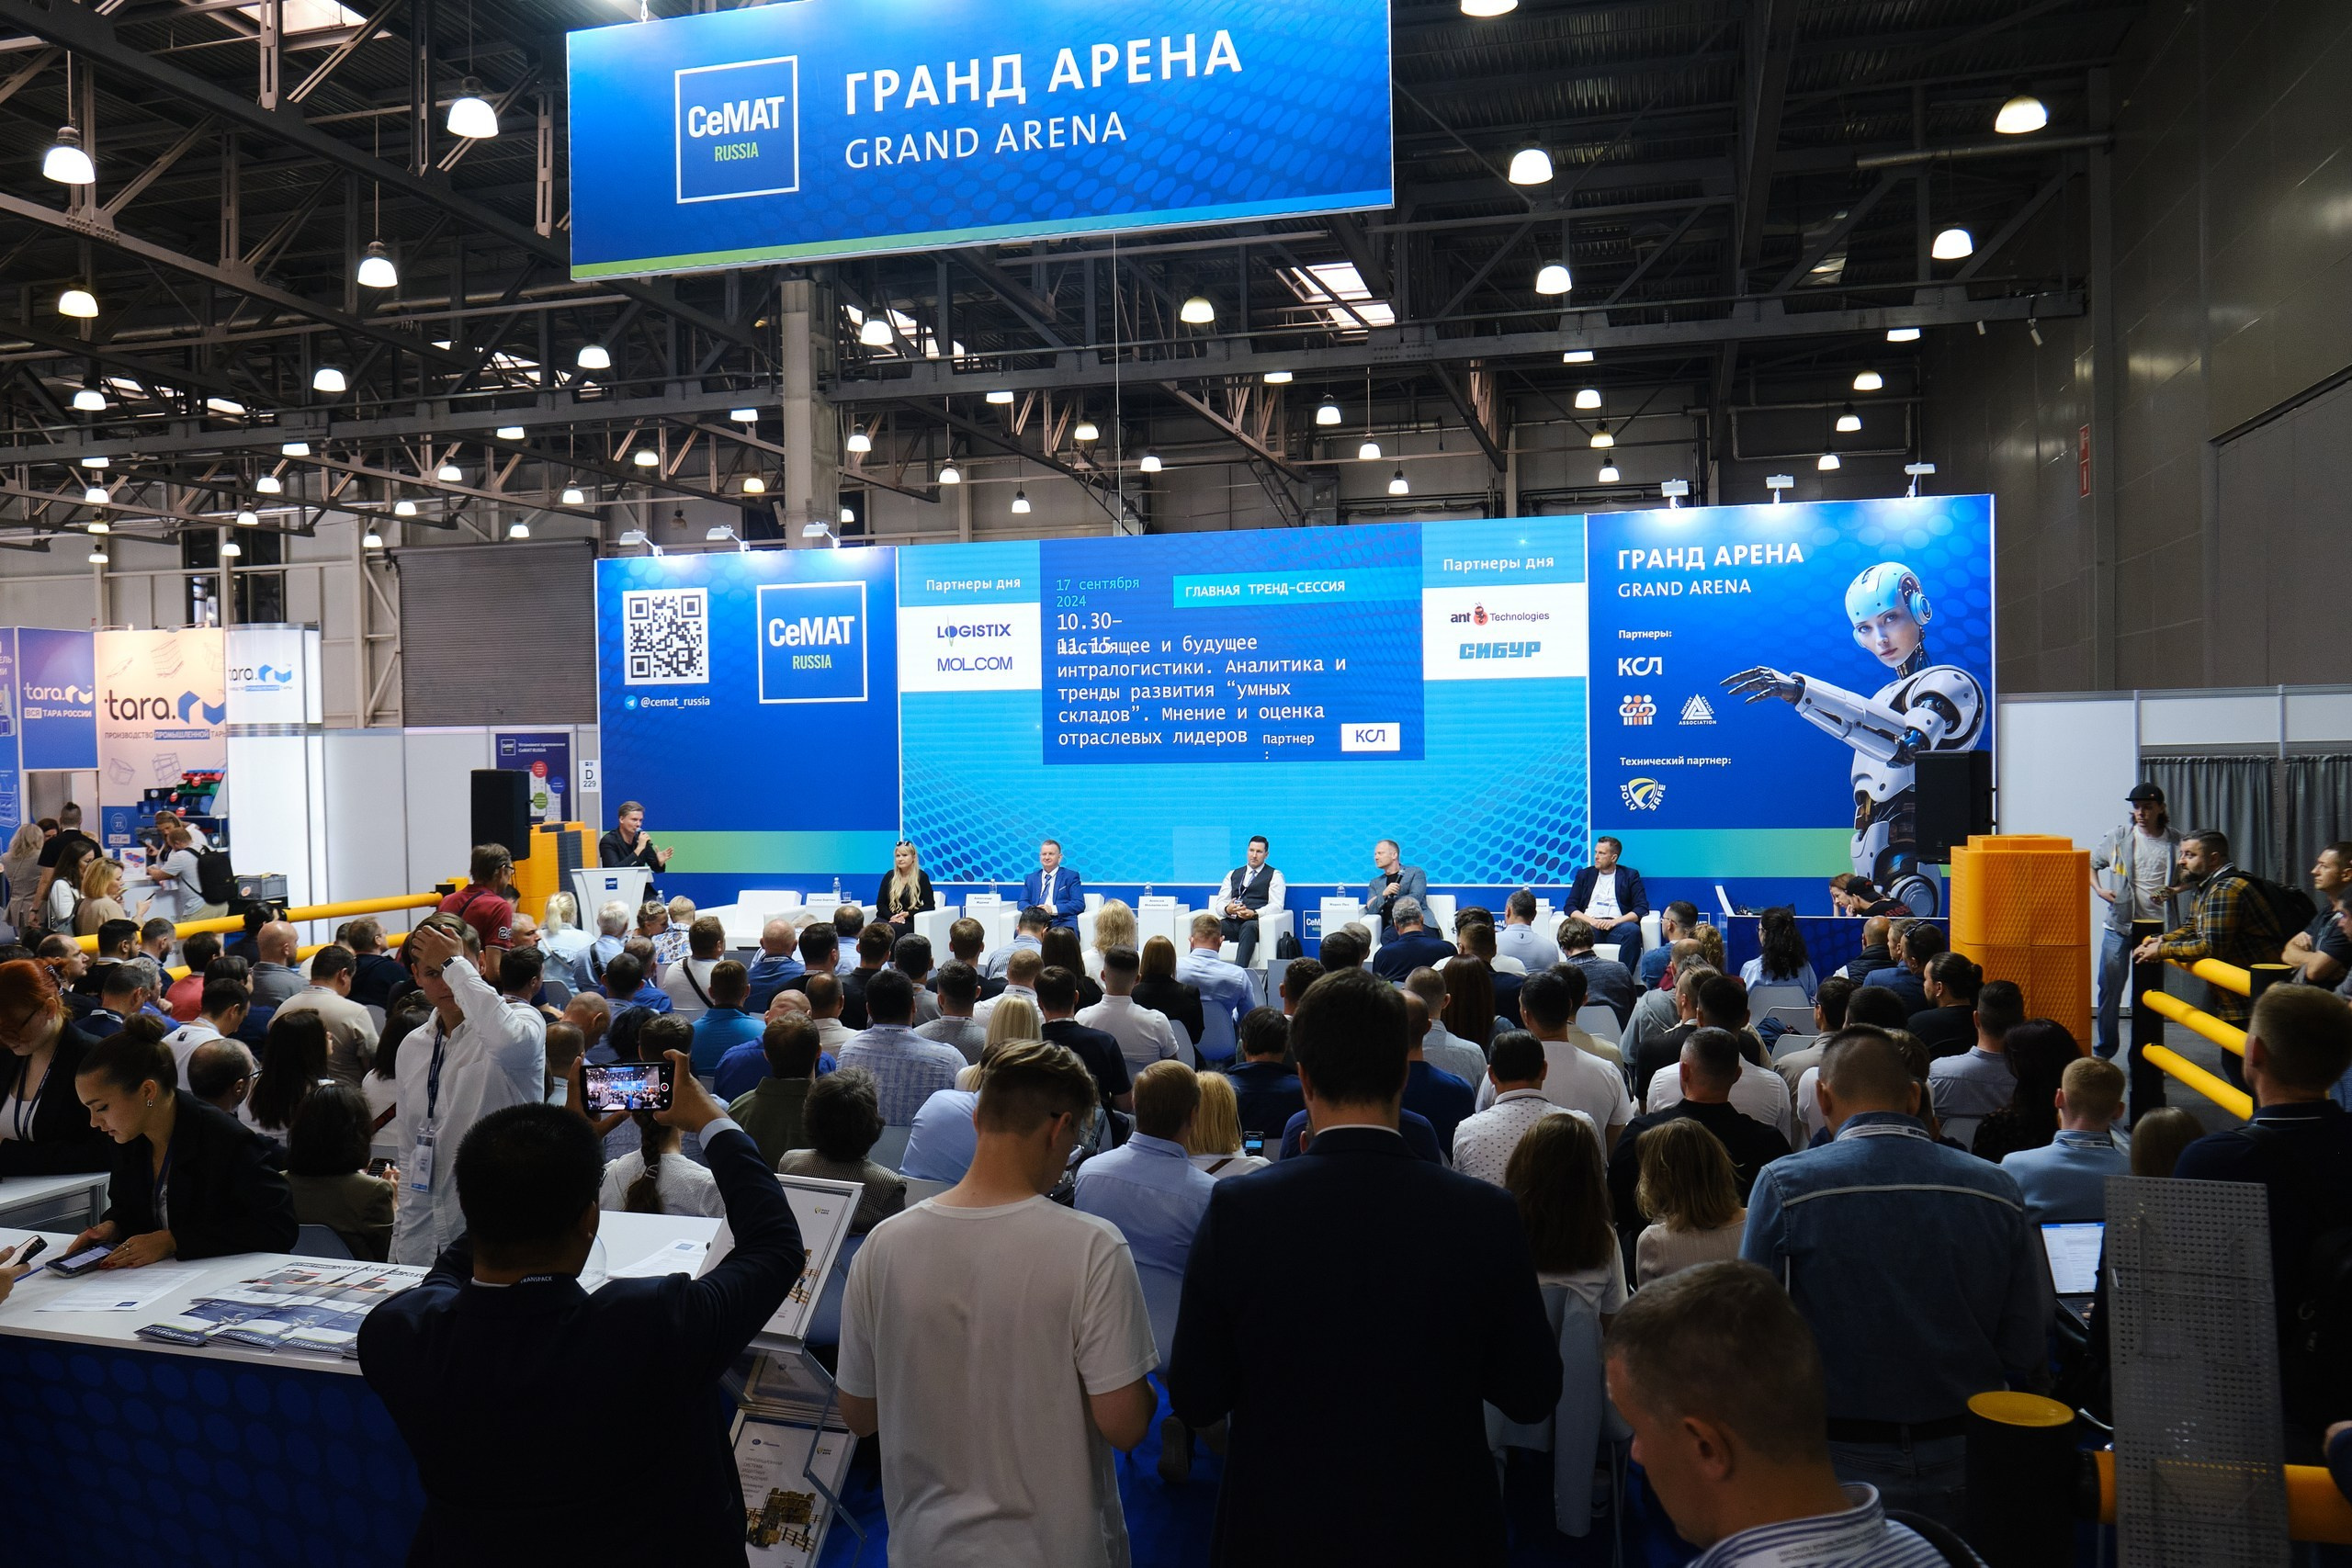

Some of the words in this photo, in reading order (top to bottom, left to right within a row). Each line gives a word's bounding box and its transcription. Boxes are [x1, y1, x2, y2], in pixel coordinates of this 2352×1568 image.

[845, 53, 1027, 117] ГРАНД
[1048, 28, 1243, 94] АРЕНА
[687, 95, 786, 140] CeMAT
[844, 126, 979, 170] GRAND
[995, 111, 1127, 152] ARENA
[714, 141, 760, 163] RUSSIA
[1443, 557, 1521, 573] Партнеры
[1526, 556, 1555, 570] дня
[1618, 547, 1706, 570] ГРАНД
[1713, 542, 1804, 566] АРЕНА
[926, 578, 992, 593] Партнеры
[997, 578, 1021, 592] дня
[1057, 579, 1071, 592] 17
[1079, 576, 1140, 592] сентября
[1185, 584, 1240, 598] ГЛАВНАЯ
[1248, 581, 1346, 596] ТРЕНД-СЕССИЯ
[1618, 581, 1683, 597] GRAND
[1689, 579, 1752, 594] ARENA
[1057, 595, 1087, 607] 2024
[1451, 611, 1471, 624] ant
[1489, 611, 1550, 623] Technologies
[768, 615, 855, 647] CeMAT
[937, 623, 1012, 638] LOGISTIX
[1618, 628, 1673, 641] Партнеры:
[1161, 640, 1171, 652] и
[1182, 636, 1258, 653] будущее
[1459, 641, 1542, 660] СИБУР
[792, 654, 832, 670] RUSSIA
[1057, 660, 1214, 678] интралогистики.
[1225, 657, 1325, 674] Аналитика
[1335, 659, 1347, 671] и
[1618, 656, 1663, 676] КСЛ
[1057, 685, 1121, 702] тренды
[1130, 684, 1216, 702] развития
[1227, 680, 1291, 701] “умных
[640, 696, 710, 709] @cemat_russia
[1680, 696, 1693, 715] IMPORT
[1701, 696, 1715, 715] EXPORT
[42, 709, 62, 717] ТАРА
[63, 709, 92, 717] РОССИИ
[1058, 706, 1150, 724] складов”.
[1161, 706, 1227, 722] Мнение
[1237, 706, 1248, 719] и
[1259, 705, 1325, 723] оценка
[104, 731, 153, 739] ПРОИЗВОДСТВО
[1058, 730, 1163, 747] отраслевых
[1172, 728, 1249, 746] лидеров
[1262, 732, 1315, 746] Партнер
[1355, 728, 1386, 743] КСЛ
[1620, 756, 1685, 766] Технический
[1687, 757, 1732, 767] партнер:
[585, 770, 594, 780] D
[1620, 784, 1638, 811] POLY
[1648, 784, 1667, 811] SAFE
[142, 1327, 199, 1341] ПУТЕВОДИТЕЛЬ
